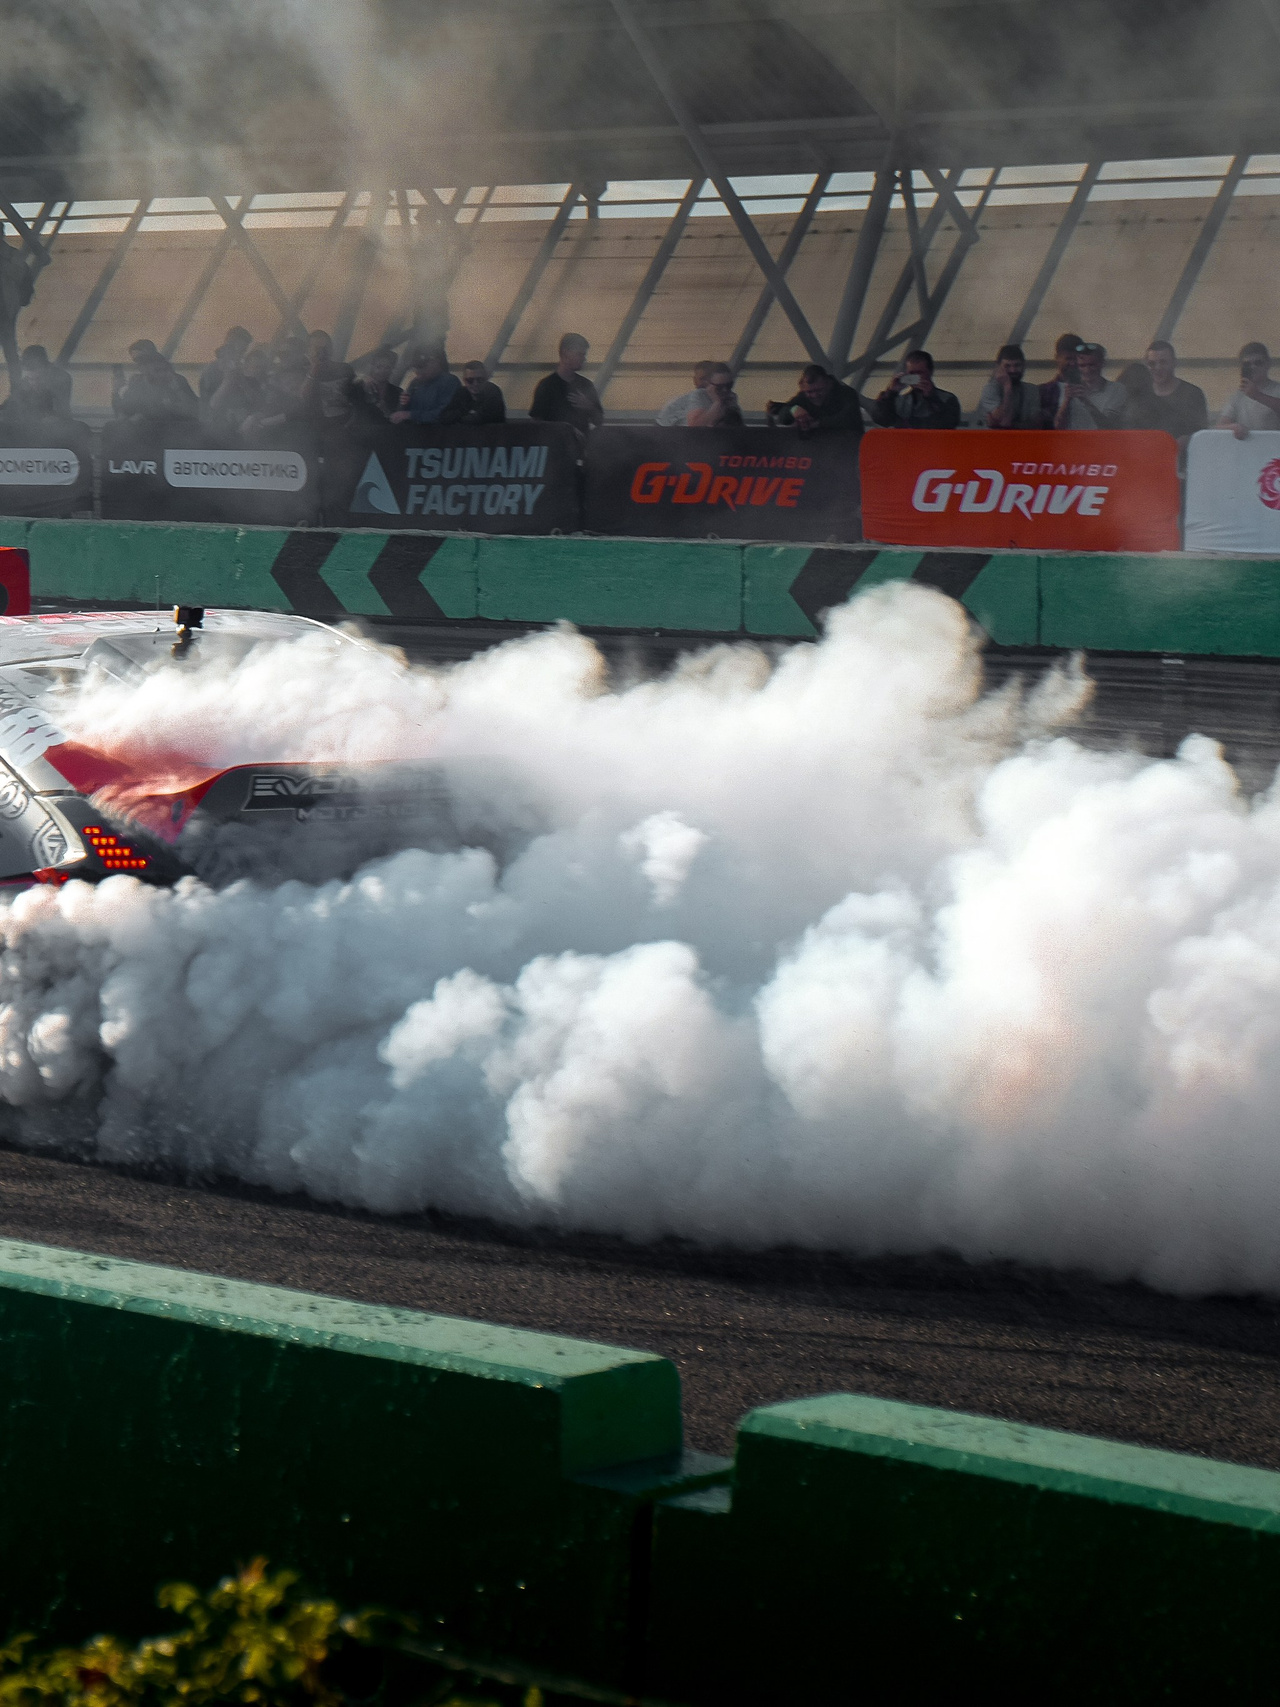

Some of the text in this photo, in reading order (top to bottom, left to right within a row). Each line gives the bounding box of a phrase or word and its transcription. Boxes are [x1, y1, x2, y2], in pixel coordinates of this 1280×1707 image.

[109, 460, 157, 475] LAVR
[405, 446, 548, 479] TSUNAMI
[720, 455, 812, 470] ТОПЛИВО
[1011, 462, 1118, 477] ТОПЛИВО
[405, 484, 546, 516] FACTORY
